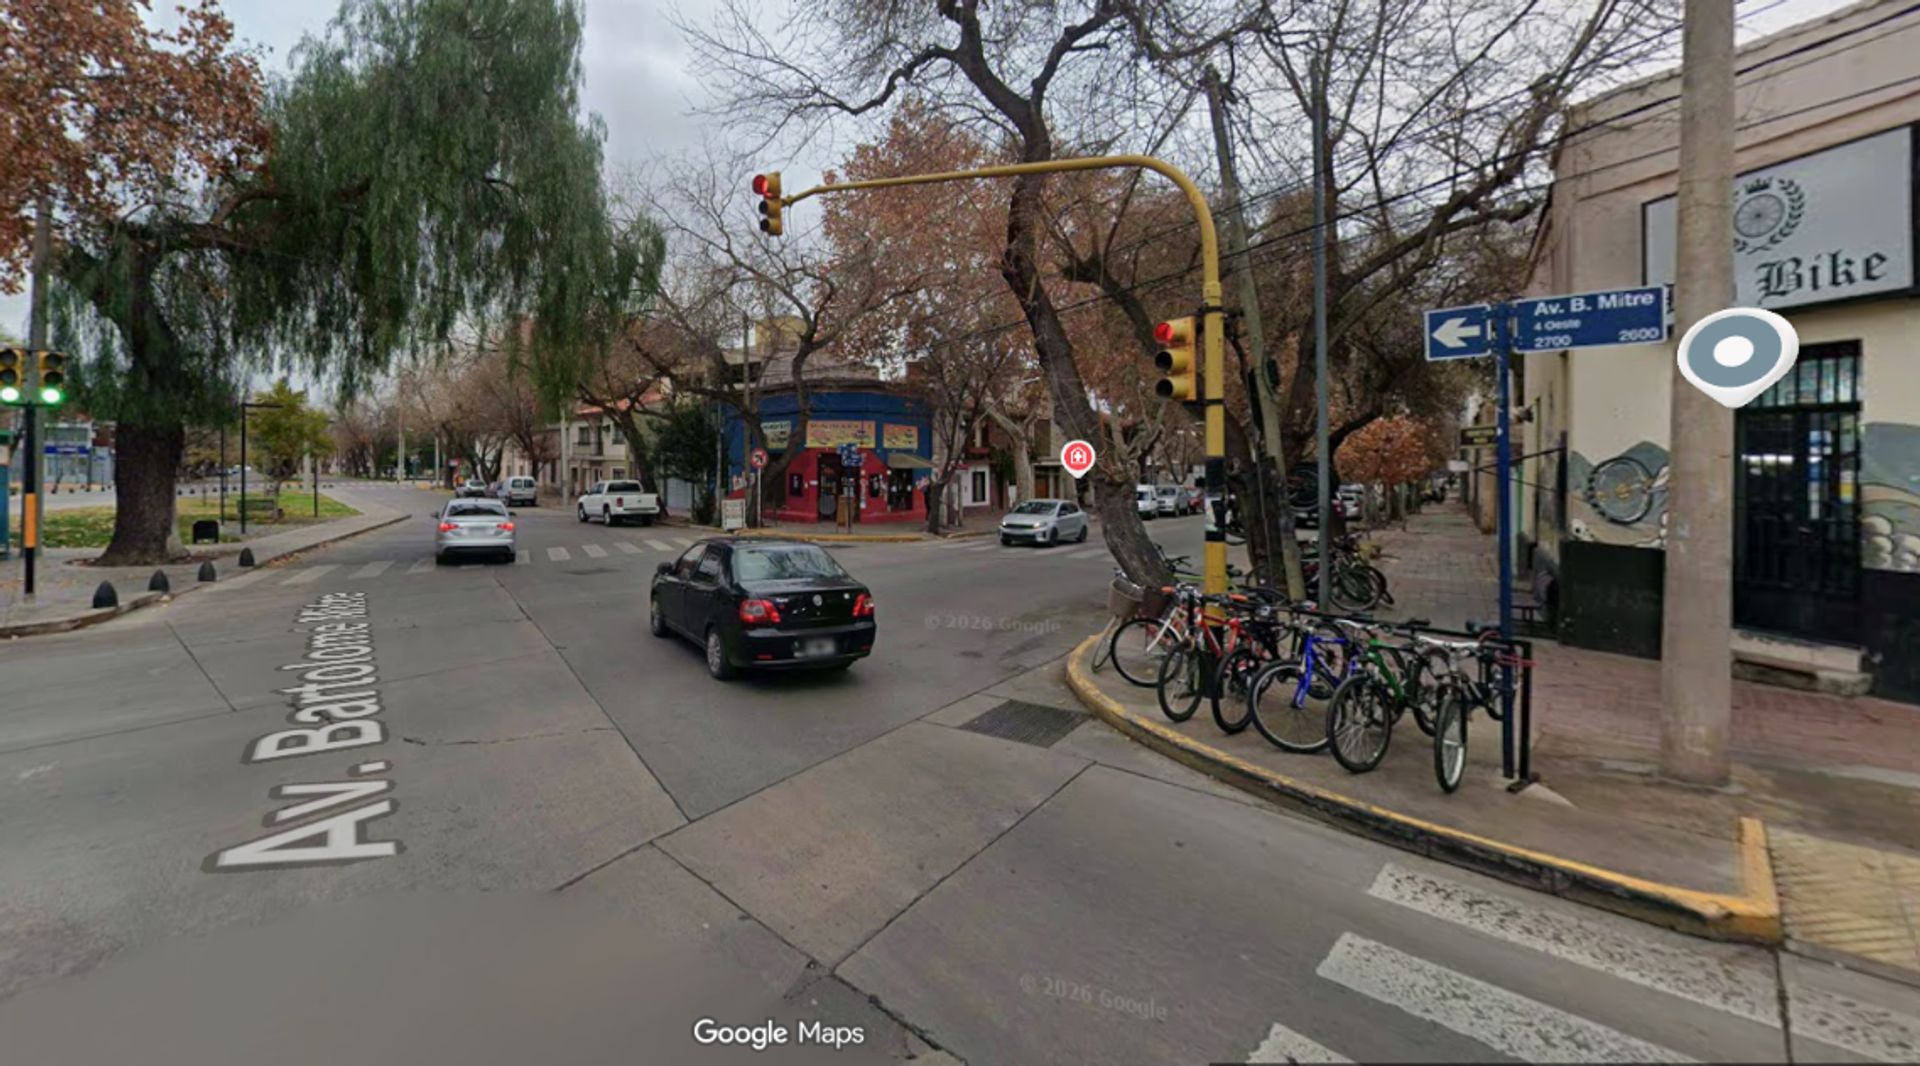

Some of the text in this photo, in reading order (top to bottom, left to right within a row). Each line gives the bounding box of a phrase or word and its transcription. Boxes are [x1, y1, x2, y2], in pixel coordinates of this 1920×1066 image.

[1756, 251, 1888, 299] Bike
[1533, 302, 1565, 317] Av.
[1570, 297, 1592, 313] B.
[1597, 292, 1655, 310] Mitre
[1533, 319, 1582, 331] 4 Oeste
[1533, 335, 1572, 348] 2700
[1618, 327, 1660, 342] 2600
